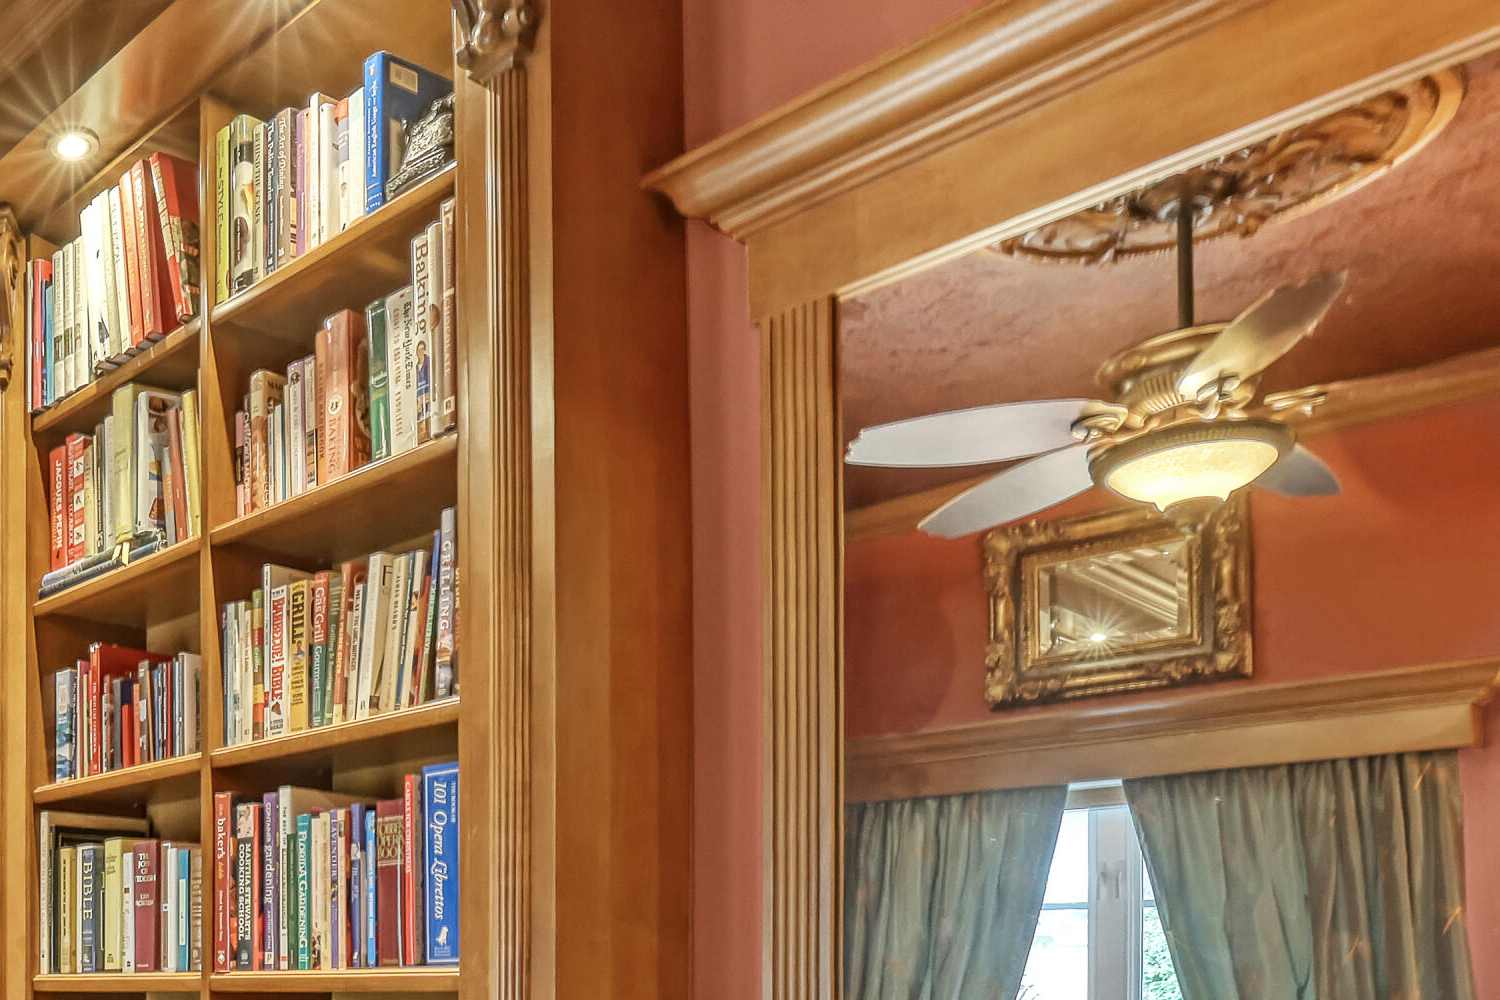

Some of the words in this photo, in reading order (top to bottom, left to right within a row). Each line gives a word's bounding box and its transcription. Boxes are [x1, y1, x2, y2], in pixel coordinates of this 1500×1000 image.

[279, 117, 287, 134] The
[276, 159, 287, 190] Dining
[217, 179, 225, 222] STYLE
[404, 300, 412, 315] The
[414, 239, 430, 336] Baking
[404, 319, 412, 339] New
[404, 359, 413, 390] Times
[327, 417, 337, 475] BAKING
[54, 459, 64, 511] JACQUES
[314, 587, 326, 613] Gas
[440, 540, 452, 631] GRILLING
[291, 590, 305, 645] GRILL
[313, 613, 325, 643] Grill
[270, 664, 284, 701] BIBLE
[313, 645, 324, 690] Gourmet
[433, 780, 448, 804] 101
[297, 830, 308, 880] FLORIDA
[430, 810, 448, 855] Opera
[83, 860, 94, 921] BIBLE
[238, 843, 246, 895] COOKING
[263, 844, 275, 904] gardening
[430, 857, 448, 920] Librettos
[297, 879, 309, 949] GARDENING
